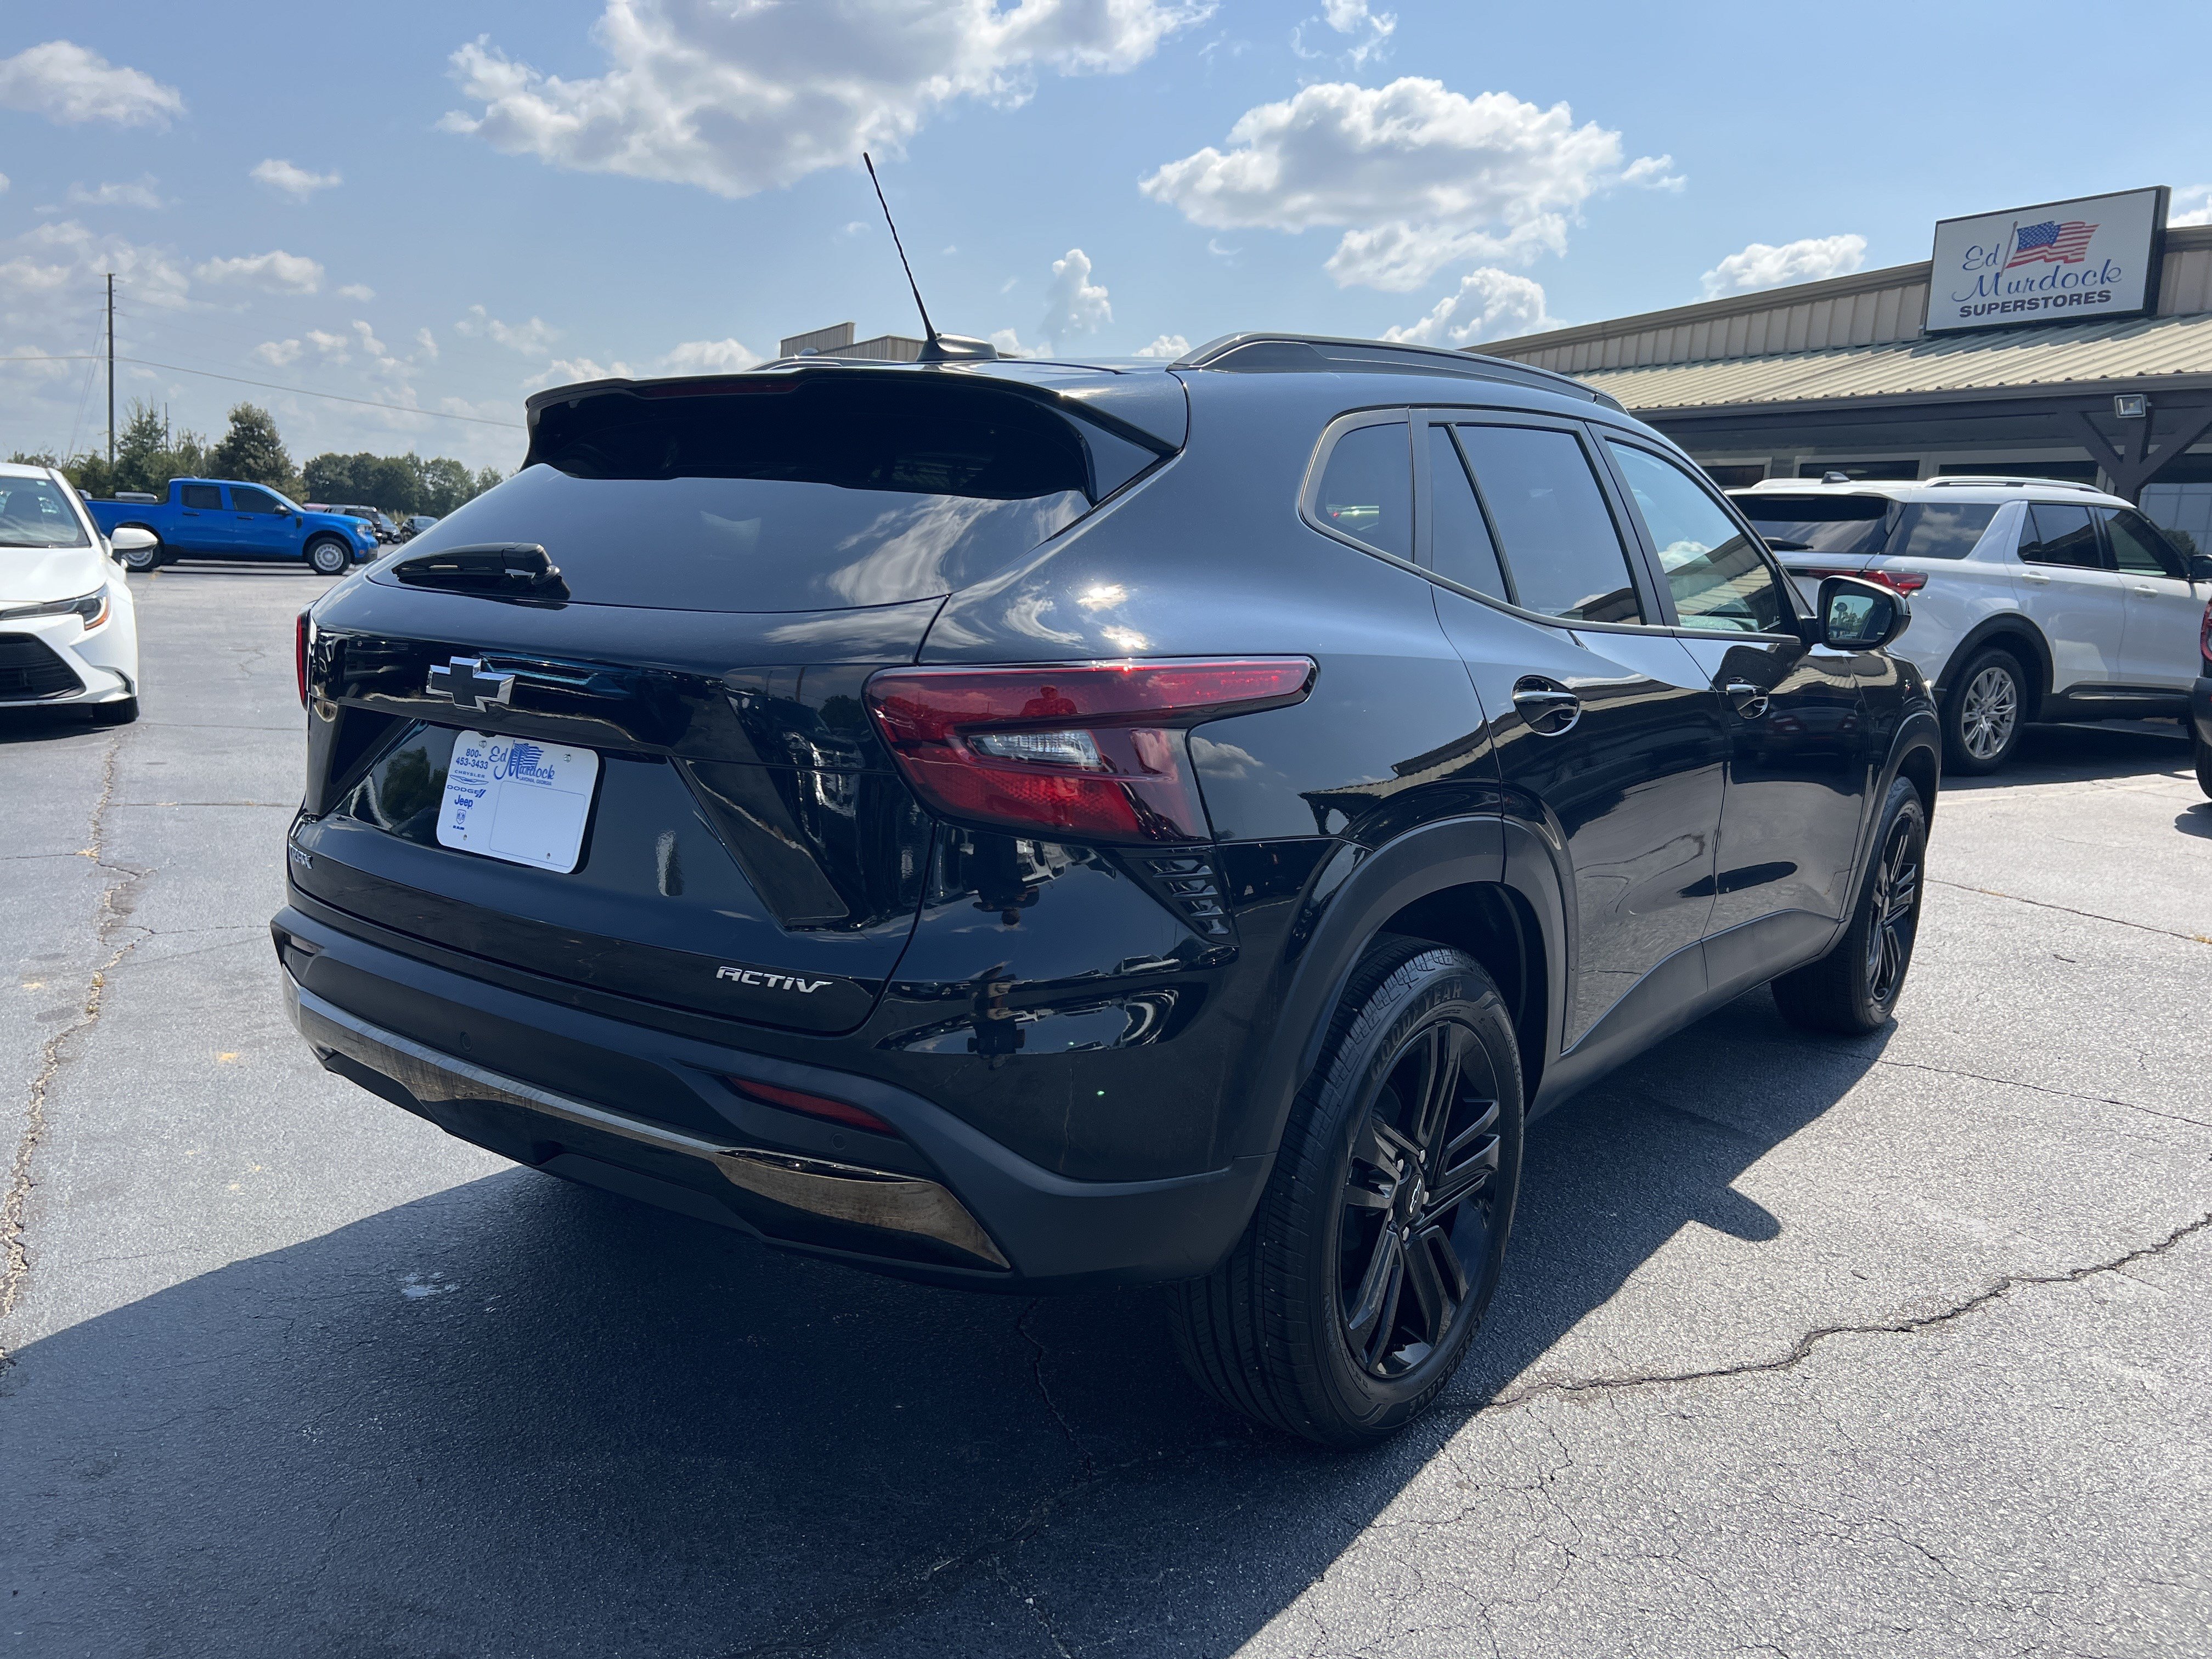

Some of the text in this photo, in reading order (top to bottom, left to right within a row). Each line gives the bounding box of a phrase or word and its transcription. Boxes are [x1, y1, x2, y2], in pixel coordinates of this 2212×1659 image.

[1962, 243, 2001, 270] Ed
[1951, 258, 2122, 302] Murdock
[1959, 289, 2112, 318] SUPERSTORES
[456, 757, 488, 770] 453-3433
[466, 748, 482, 758] 800-
[489, 746, 509, 762] Ed
[454, 769, 486, 778] CHRYSLER
[494, 748, 555, 780] Murdock
[447, 785, 481, 794] DODGE
[454, 794, 473, 809] Jeep
[716, 966, 834, 993] ACTIV
[1370, 979, 1463, 1081] GOODYEAR
